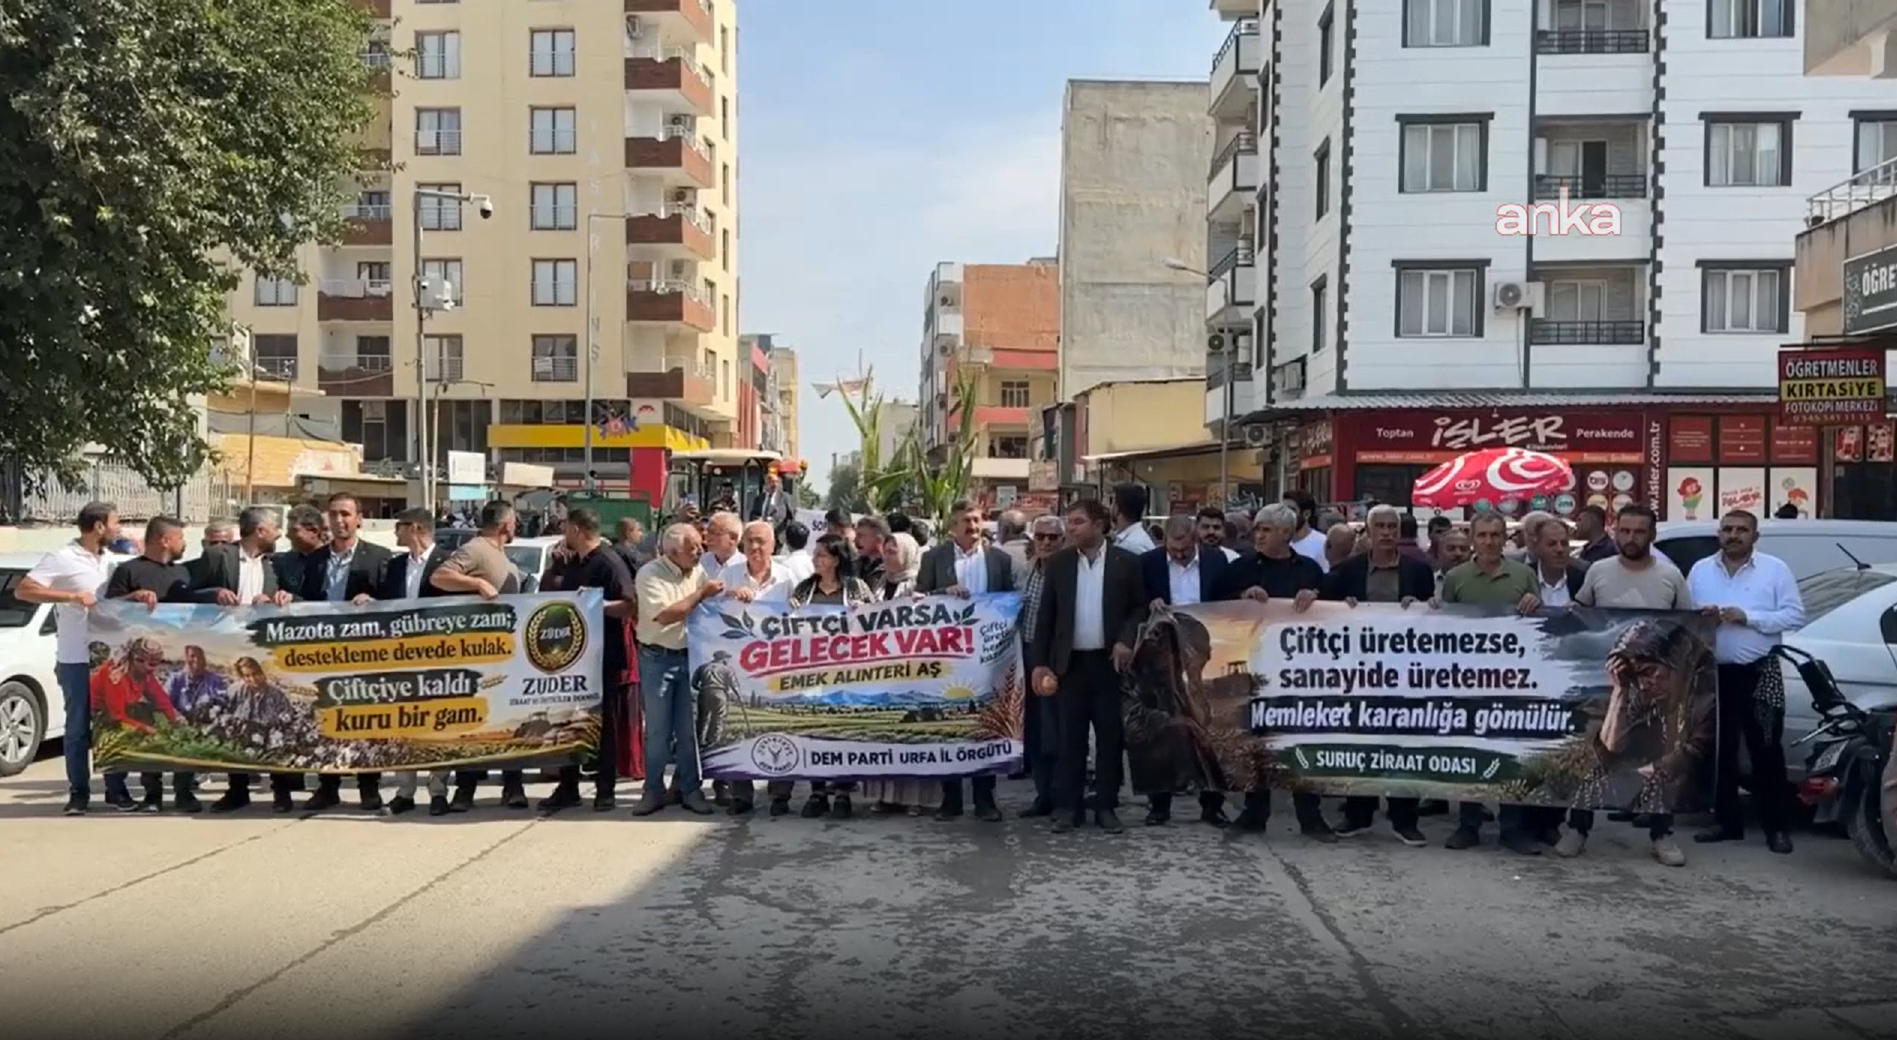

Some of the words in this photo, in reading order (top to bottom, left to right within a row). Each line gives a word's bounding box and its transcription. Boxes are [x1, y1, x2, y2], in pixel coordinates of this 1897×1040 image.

[1862, 263, 1897, 296] ÖĞRE
[1785, 357, 1877, 378] ÖĞRETMENLER
[1376, 428, 1413, 438] Toptan
[1576, 428, 1634, 438] Perakende
[266, 621, 335, 642] Mazota
[340, 622, 386, 638] zam,
[390, 614, 466, 637] gübreye
[470, 612, 512, 630] zam;
[761, 612, 849, 639] ÇİFTÇİ
[857, 604, 952, 633] VARSA
[284, 645, 389, 667] destekleme
[393, 639, 456, 660] devede
[460, 637, 512, 657] kulak.
[739, 632, 889, 672] GELECEK
[893, 627, 974, 655] VAR!
[1280, 626, 1349, 660] Çiftçi
[1360, 627, 1525, 658] üretemezse,
[327, 677, 412, 705] Çiftçiye
[417, 672, 471, 697] kaldı
[780, 673, 829, 690] EMEK
[833, 663, 910, 685] ALINTERİ
[917, 662, 942, 678] AŞ
[1279, 661, 1399, 694] sanayide
[1408, 662, 1538, 689] üretemez.
[335, 709, 391, 732] kuru
[398, 705, 430, 728] bir
[433, 707, 483, 730] gam.
[1251, 701, 1352, 728] Memleket
[1358, 701, 1467, 734] karanlığa
[1475, 703, 1575, 735] gömülür.
[811, 751, 843, 765] DEM
[848, 748, 893, 765] PARTİ
[900, 751, 936, 764] URFA
[941, 749, 953, 763] İL
[956, 742, 1012, 761] ÖRGÜTÜ
[1316, 750, 1366, 772] SURUÇ
[1370, 749, 1424, 771] ZİRAAT
[1429, 755, 1476, 774] ODASI
